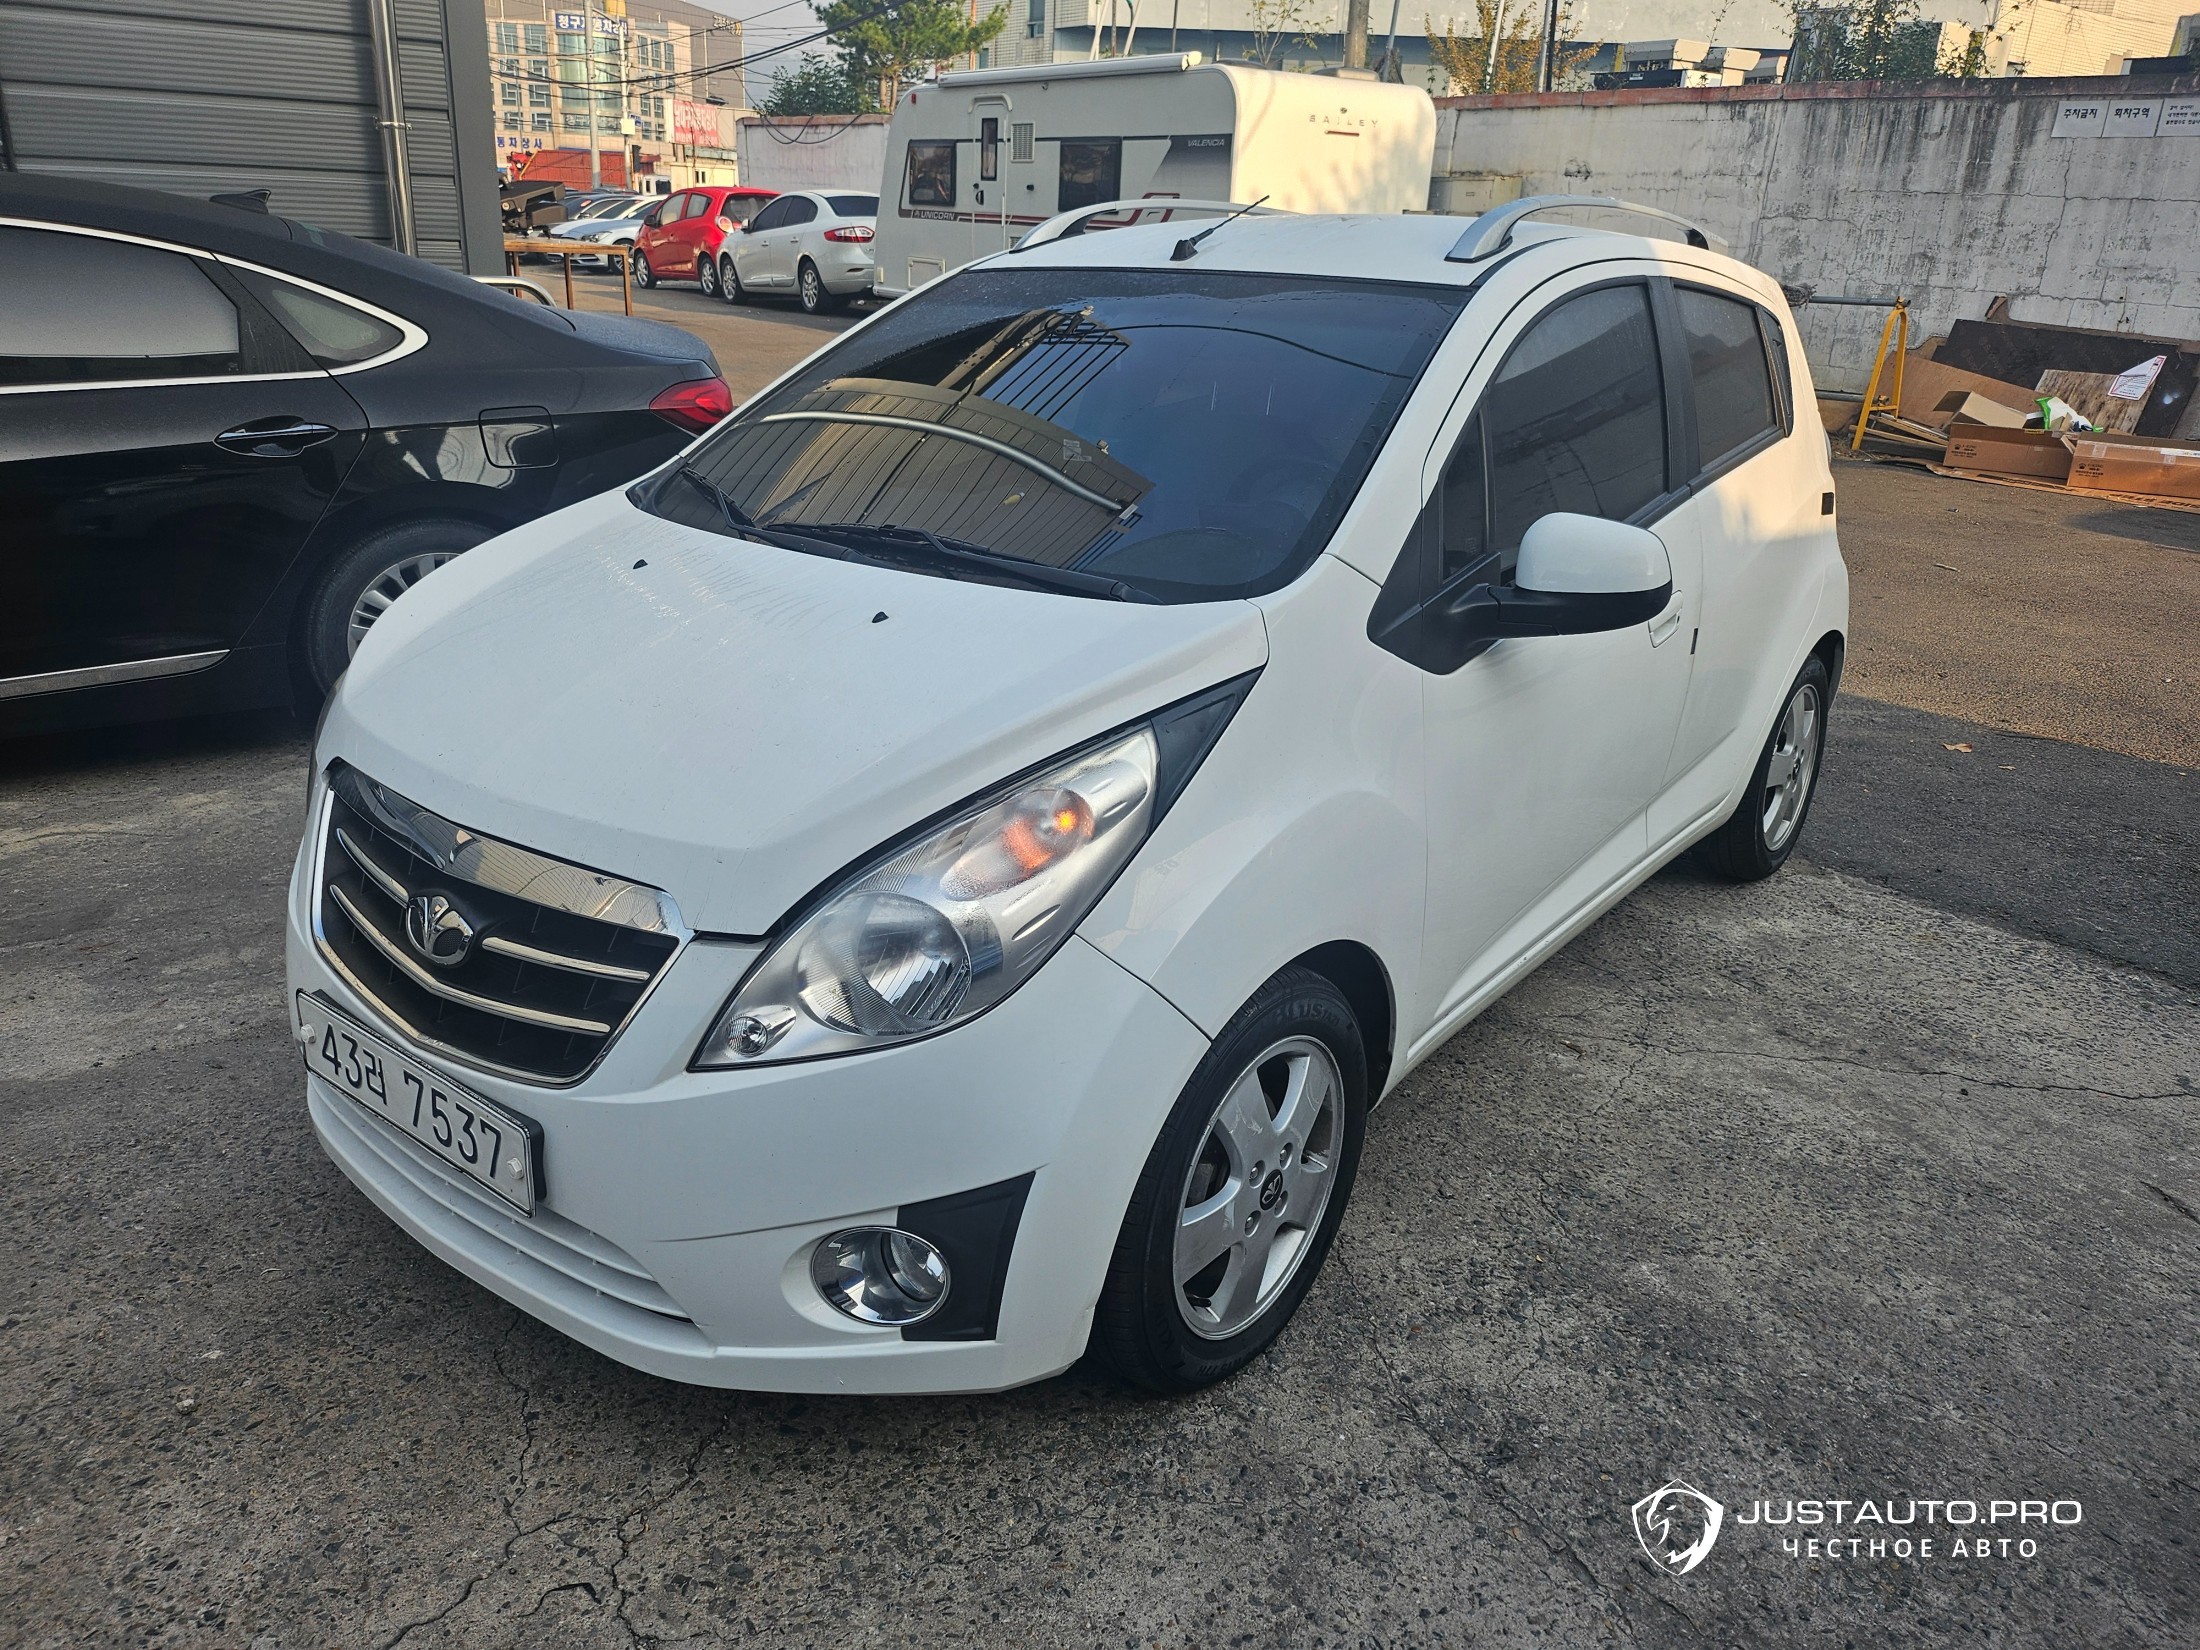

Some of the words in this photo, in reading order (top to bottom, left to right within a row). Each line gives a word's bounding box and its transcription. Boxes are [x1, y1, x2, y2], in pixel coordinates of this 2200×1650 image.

[2063, 107, 2098, 119] 주차금지
[2114, 107, 2150, 119] 회차구역
[1308, 114, 1379, 129] BAILEY
[1187, 138, 1226, 148] VALENCIA
[920, 210, 956, 221] UNICORN
[321, 1021, 388, 1106] 43러
[402, 1067, 502, 1180] 7537
